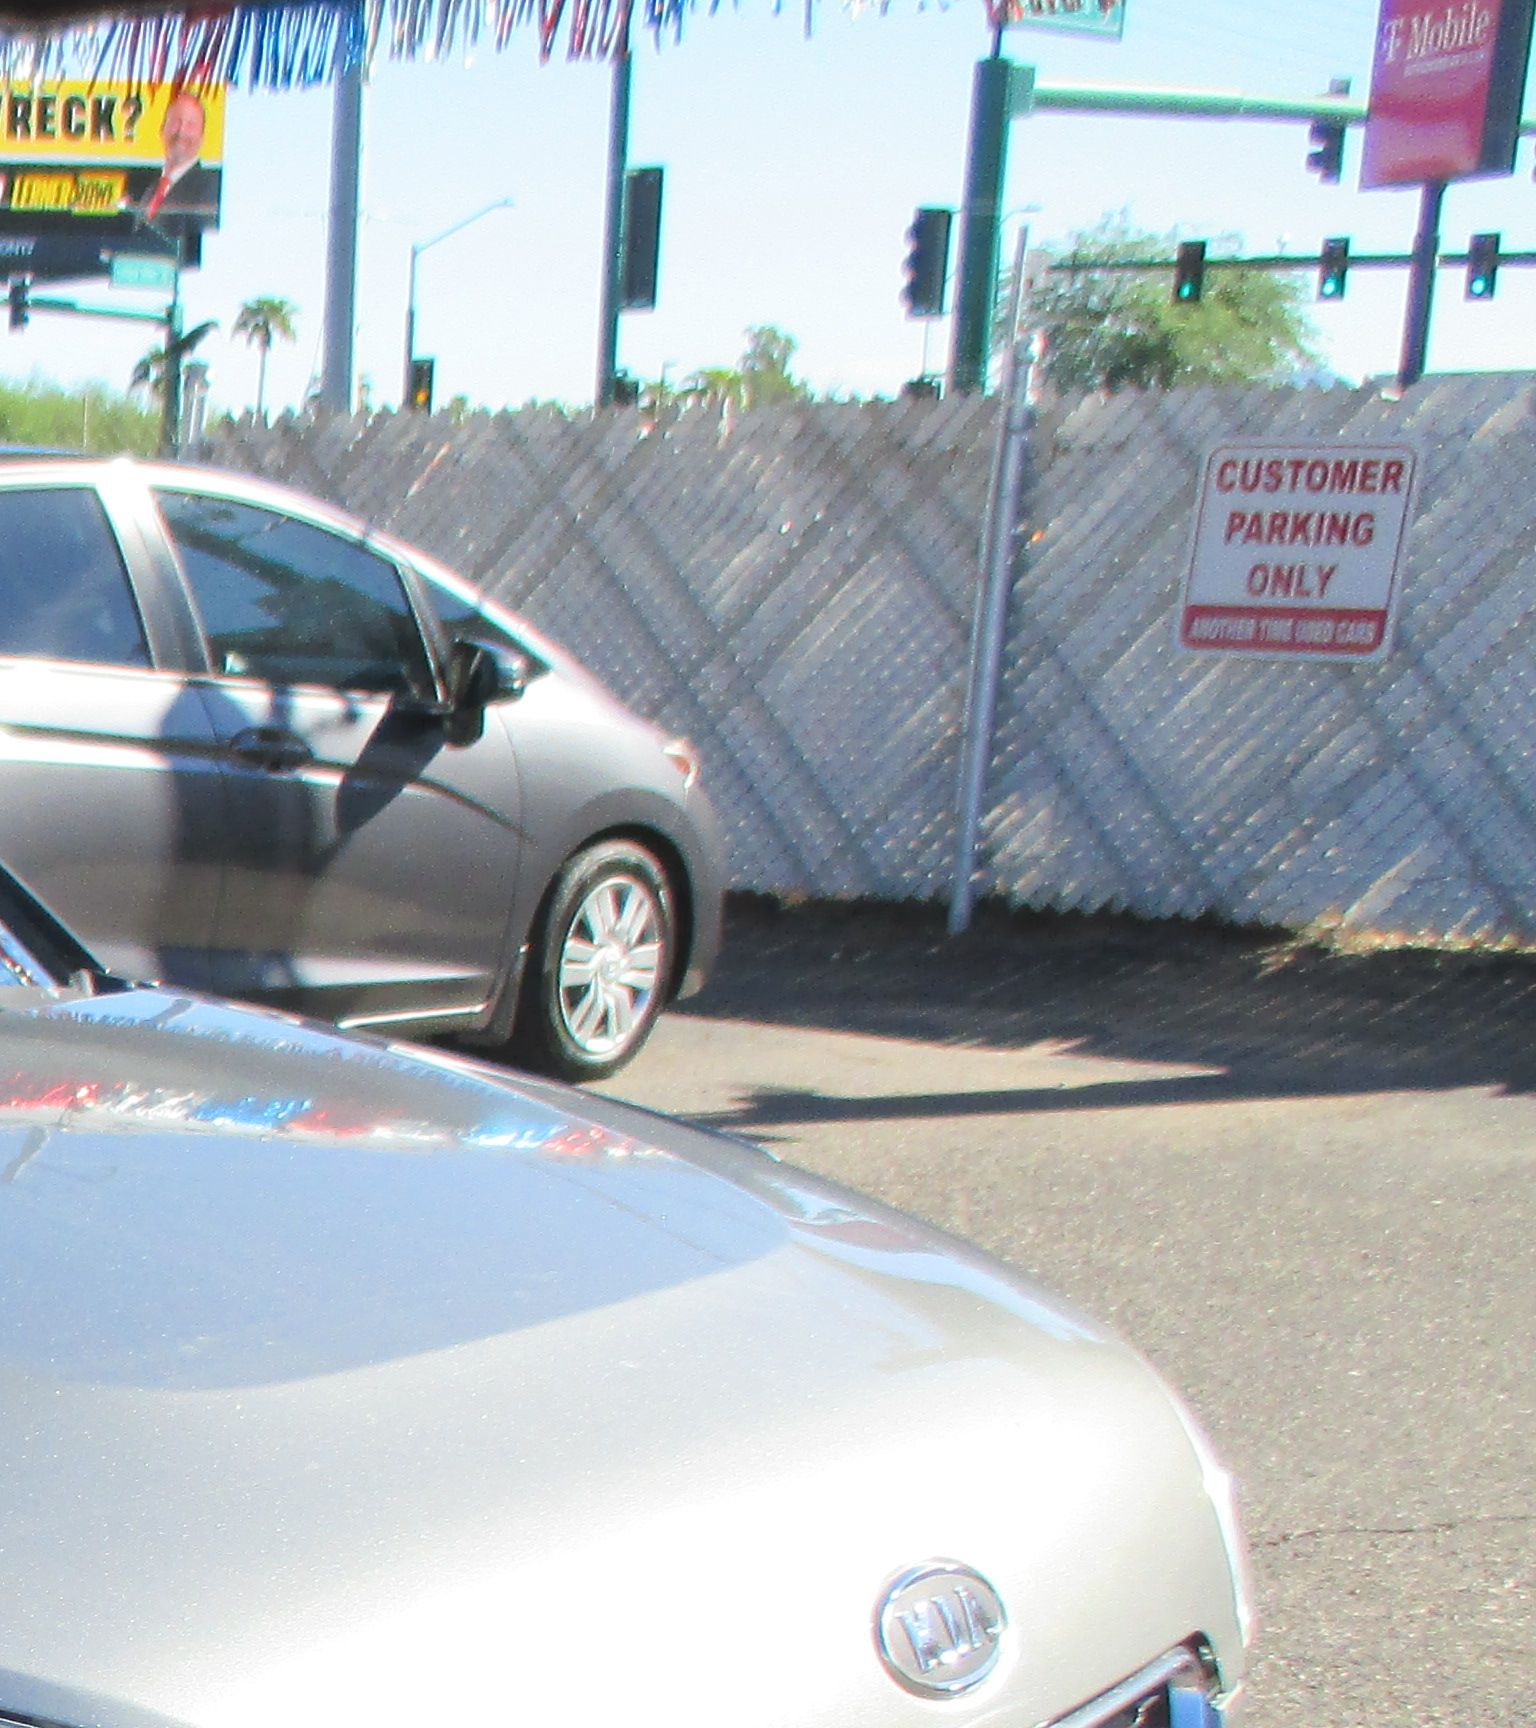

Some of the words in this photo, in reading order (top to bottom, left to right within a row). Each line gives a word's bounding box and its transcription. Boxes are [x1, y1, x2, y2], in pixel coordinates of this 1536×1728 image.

[1216, 458, 1404, 494] CUSTOMER
[1224, 510, 1376, 547] PARKING
[1246, 562, 1339, 599] ONLY
[894, 1585, 1000, 1675] KIA
